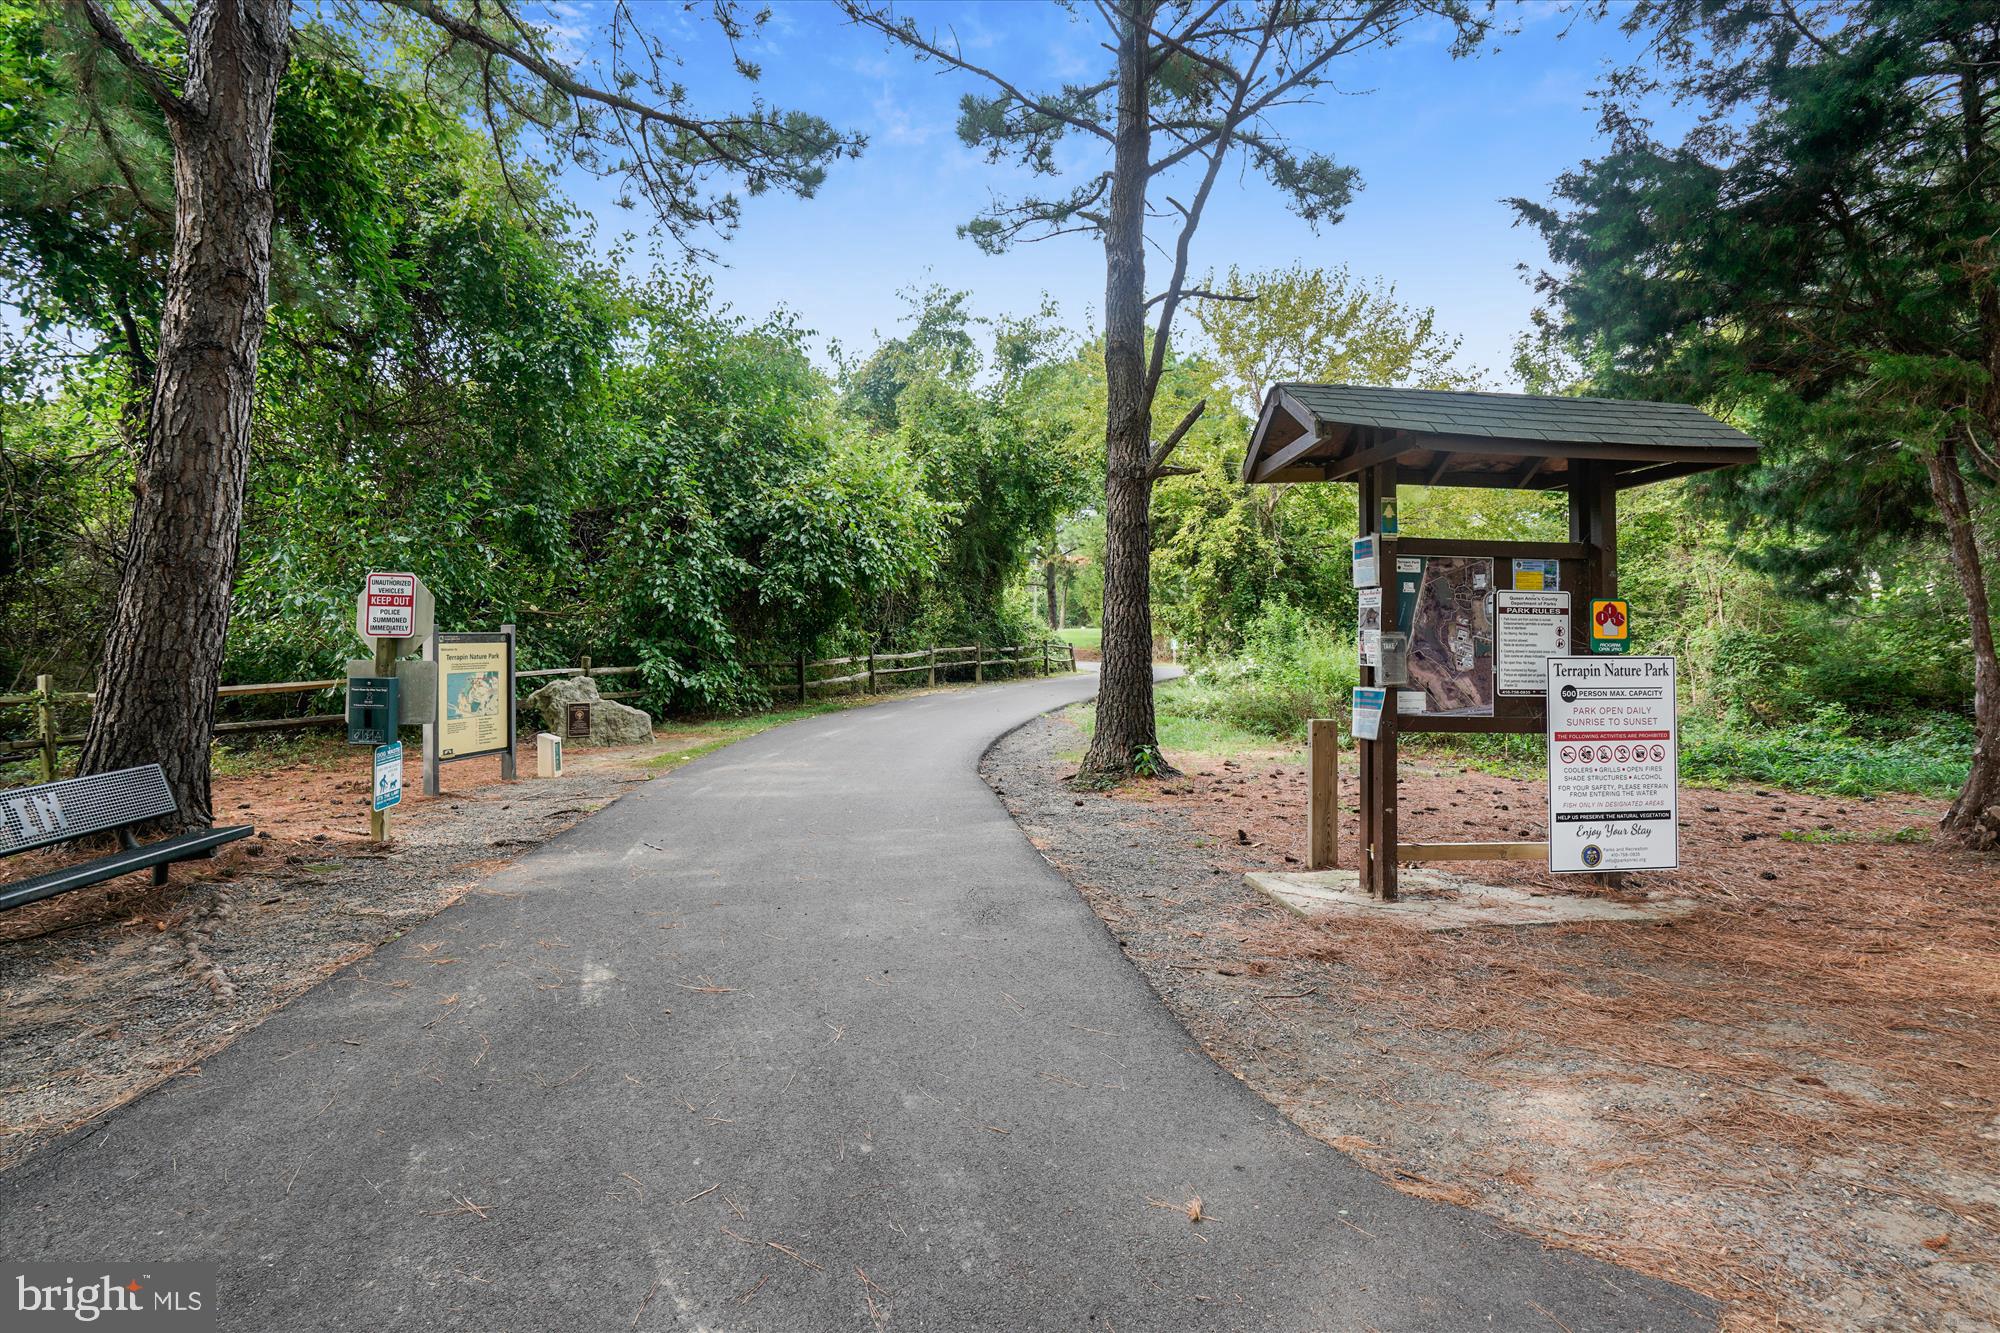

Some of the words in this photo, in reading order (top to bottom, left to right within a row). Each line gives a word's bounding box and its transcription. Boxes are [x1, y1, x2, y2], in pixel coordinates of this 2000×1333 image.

[371, 579, 411, 587] UNAUTHORIZED
[371, 596, 391, 605] KEEP
[393, 597, 410, 605] OUT
[446, 653, 468, 661] Terrapin
[1553, 663, 1600, 679] Terrapin
[1604, 663, 1641, 676] Nature
[1645, 662, 1669, 676] Park
[1561, 690, 1576, 698] 500
[1566, 718, 1605, 726] SUNRISE
[1576, 825, 1601, 839] Enjoy
[1605, 824, 1628, 838] Your
[1630, 823, 1651, 837] Stay
